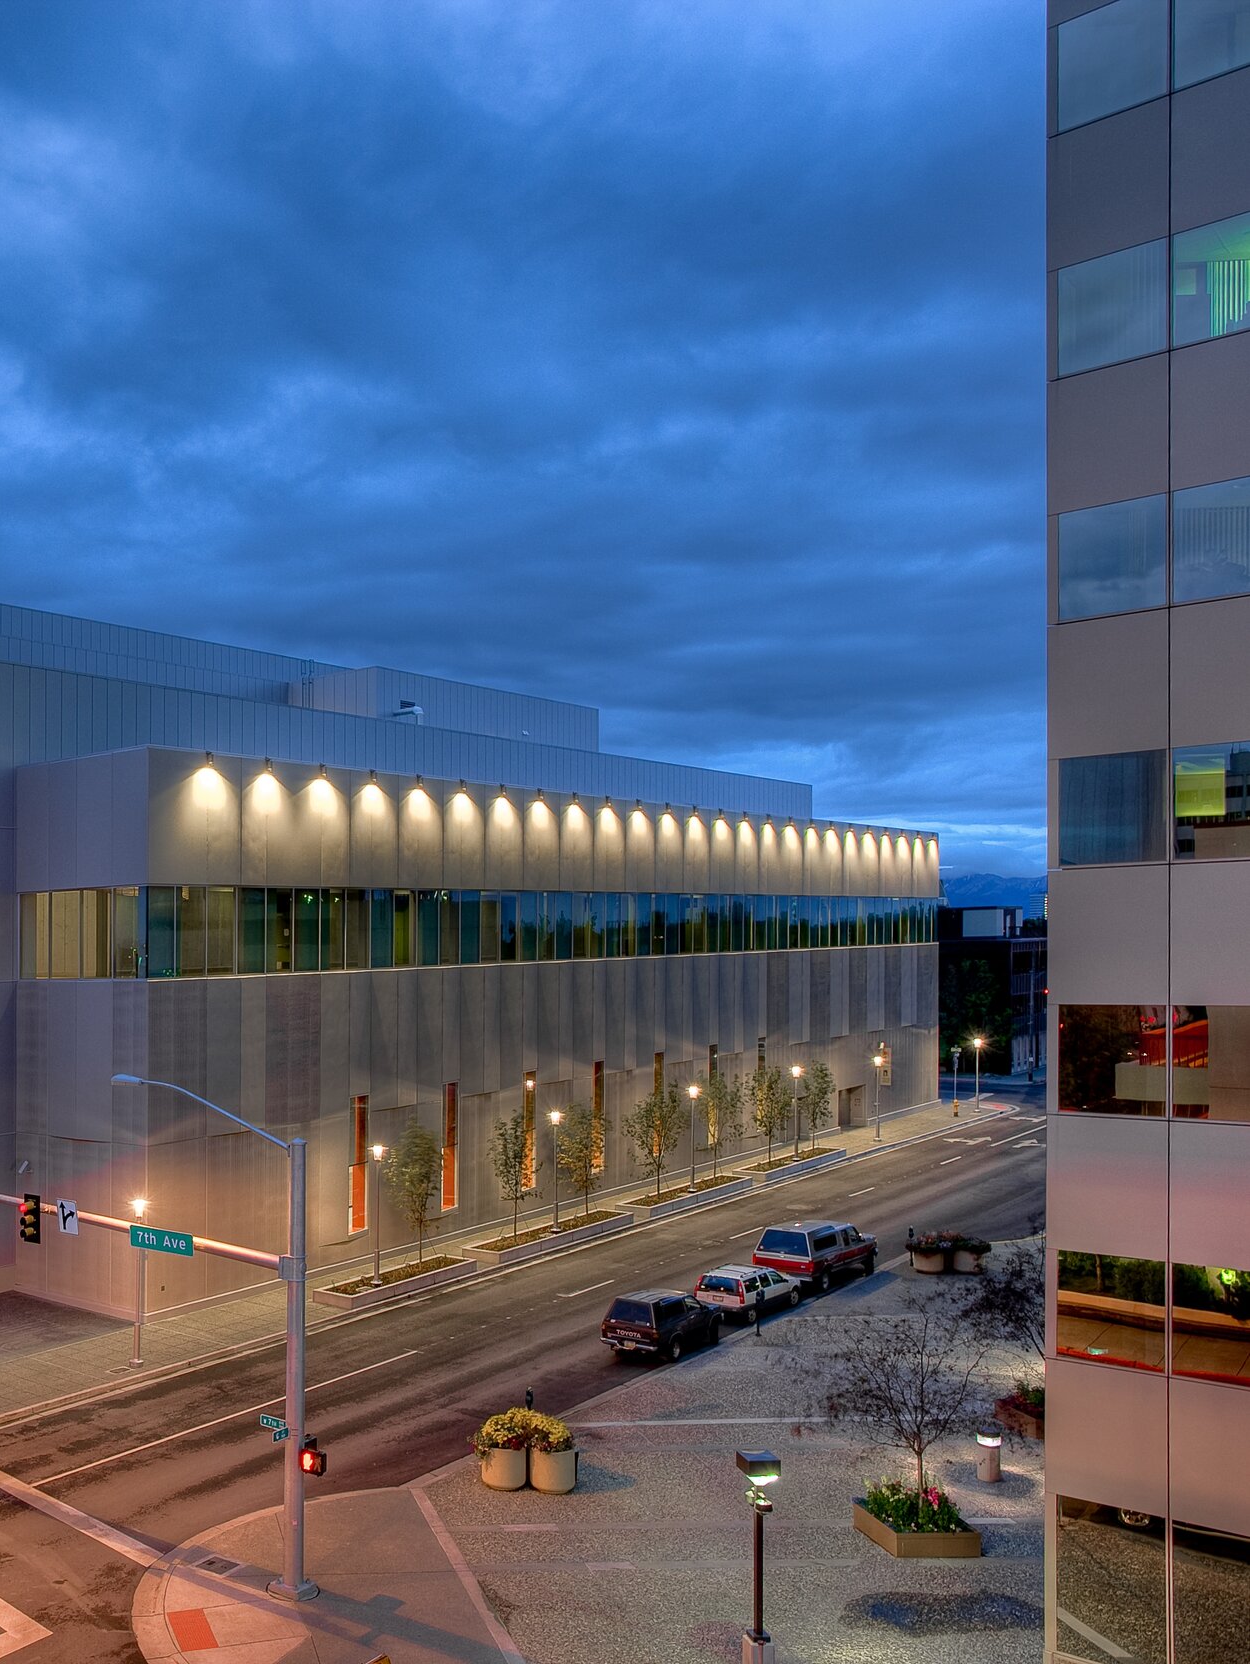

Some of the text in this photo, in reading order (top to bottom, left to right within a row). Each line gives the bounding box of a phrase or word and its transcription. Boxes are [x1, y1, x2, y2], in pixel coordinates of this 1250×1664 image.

[136, 1231, 186, 1250] 7th Ave
[616, 1329, 642, 1339] TOYOTA
